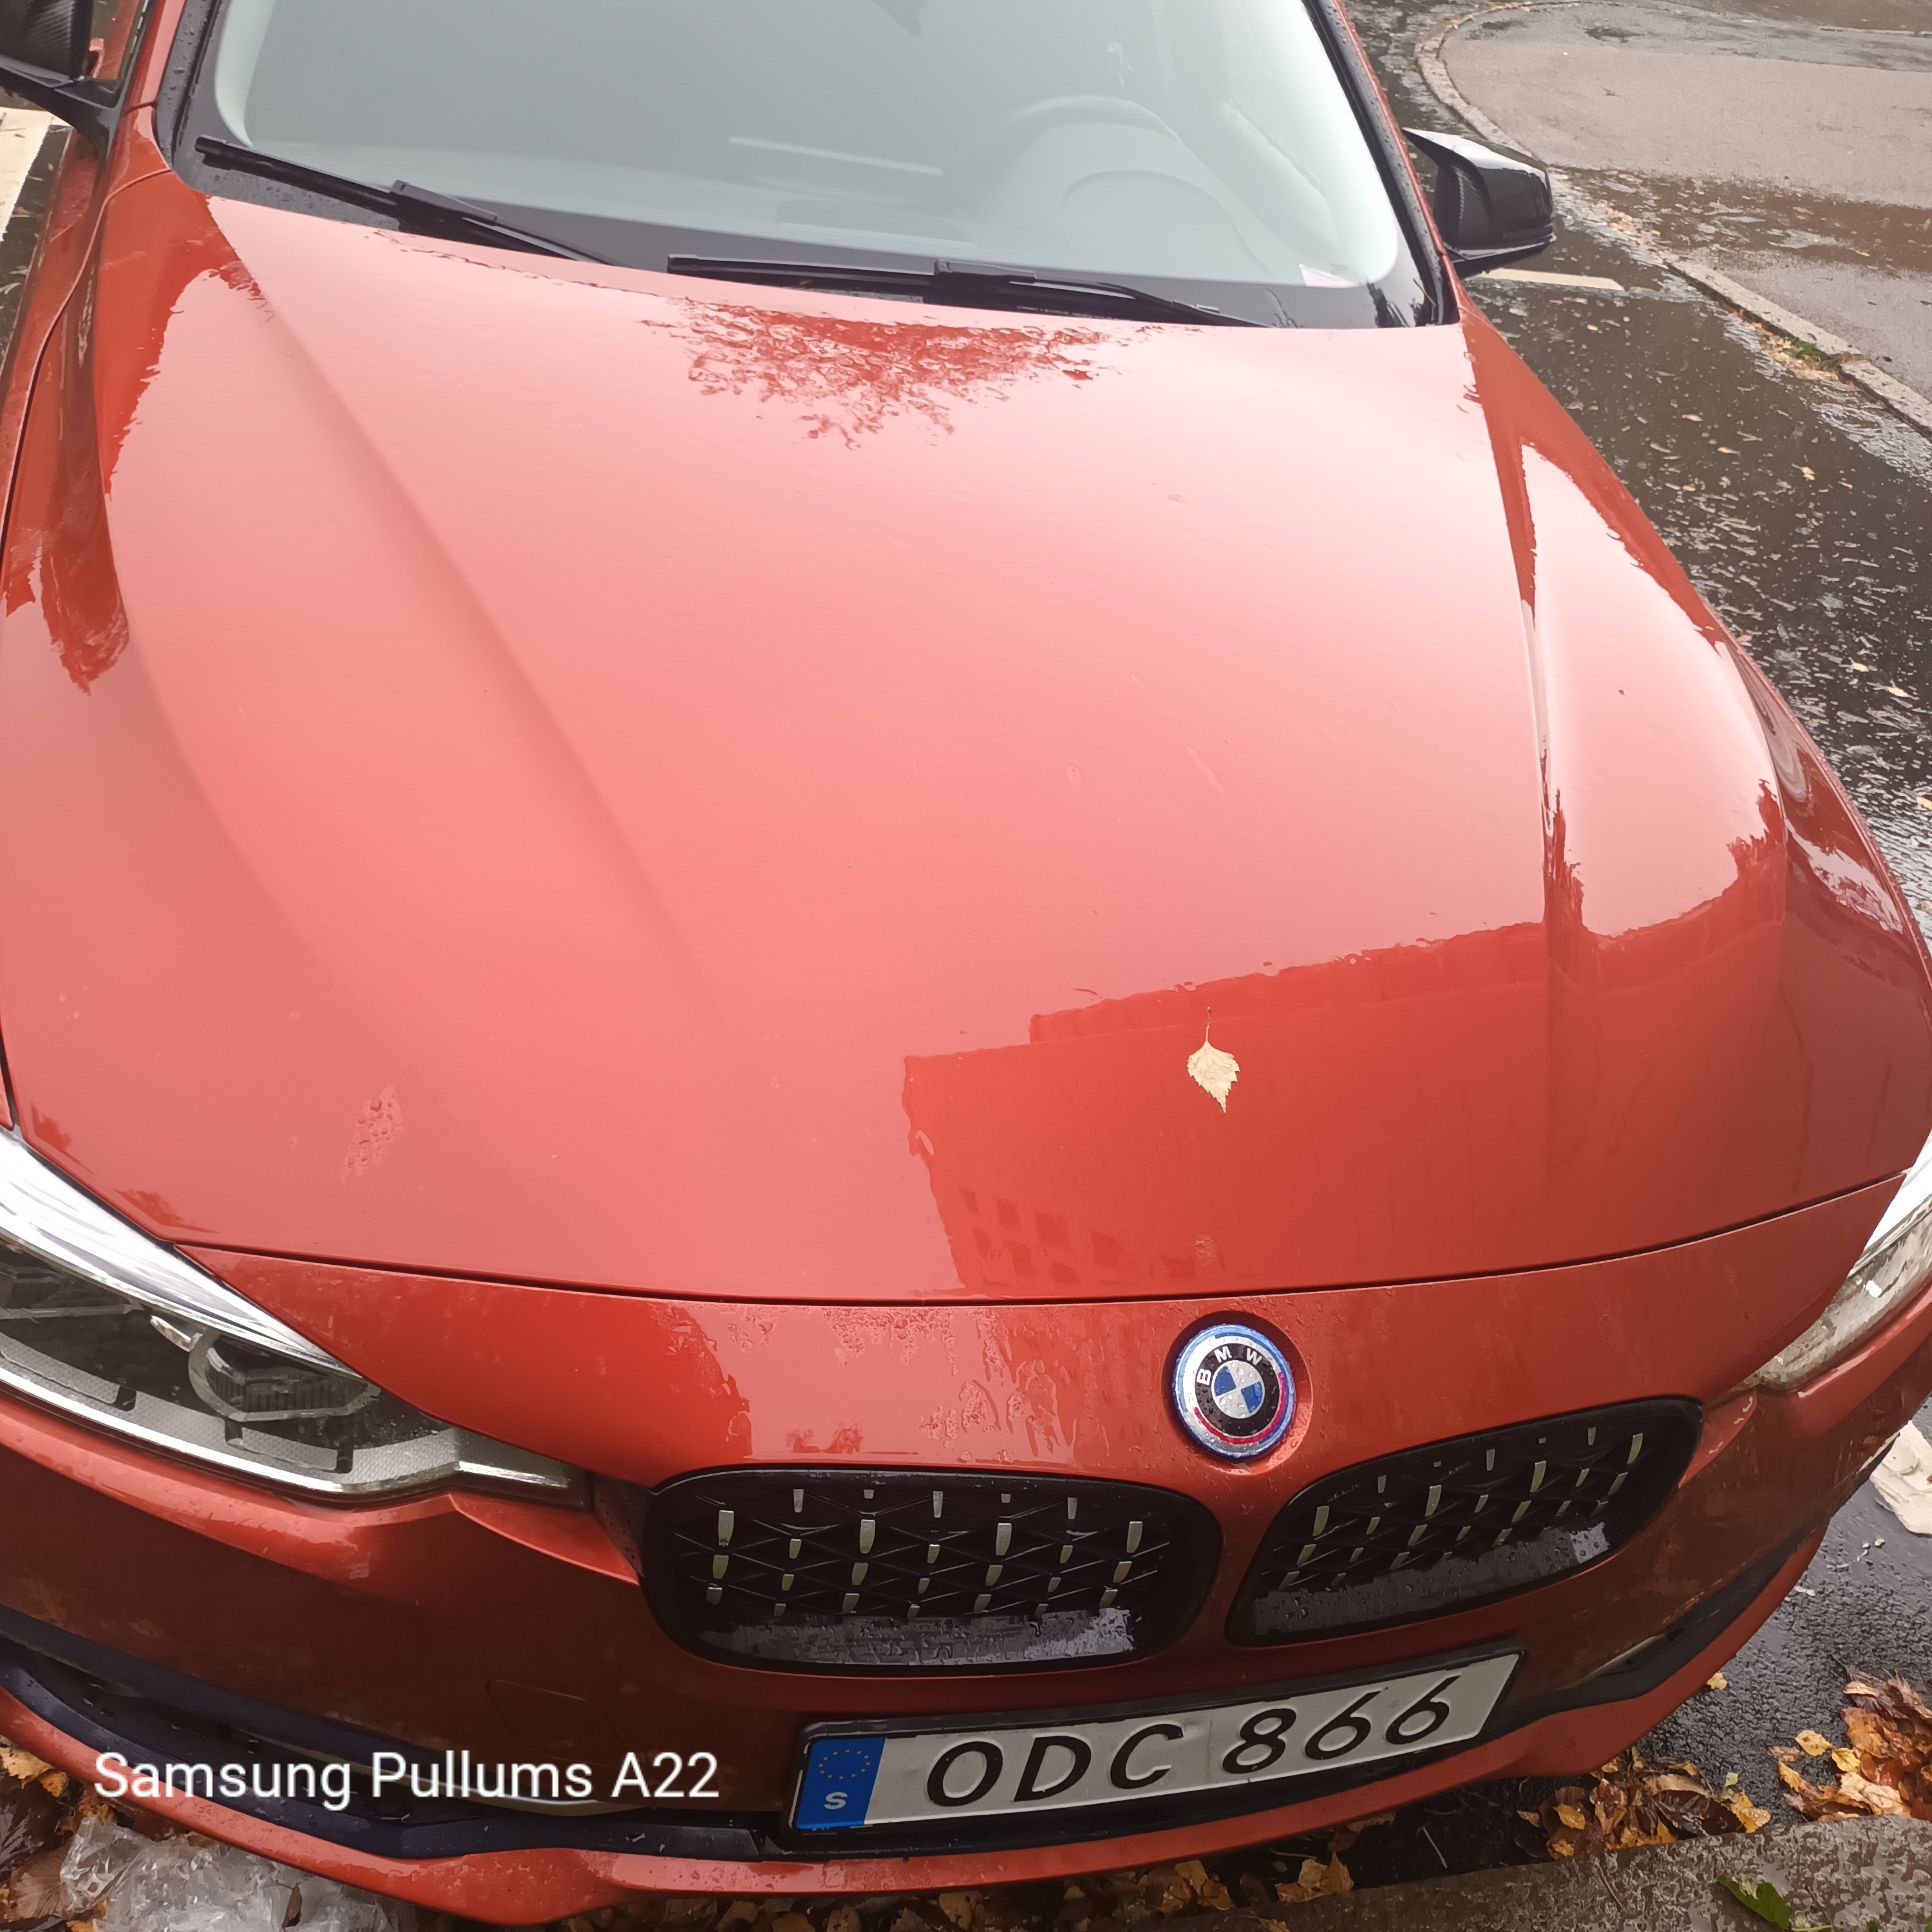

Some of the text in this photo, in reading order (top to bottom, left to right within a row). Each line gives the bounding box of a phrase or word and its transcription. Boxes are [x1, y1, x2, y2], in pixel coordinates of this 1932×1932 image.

[1196, 1345, 1263, 1385] BMW
[926, 1674, 1461, 1808] ODC 866
[824, 1792, 848, 1810] S
